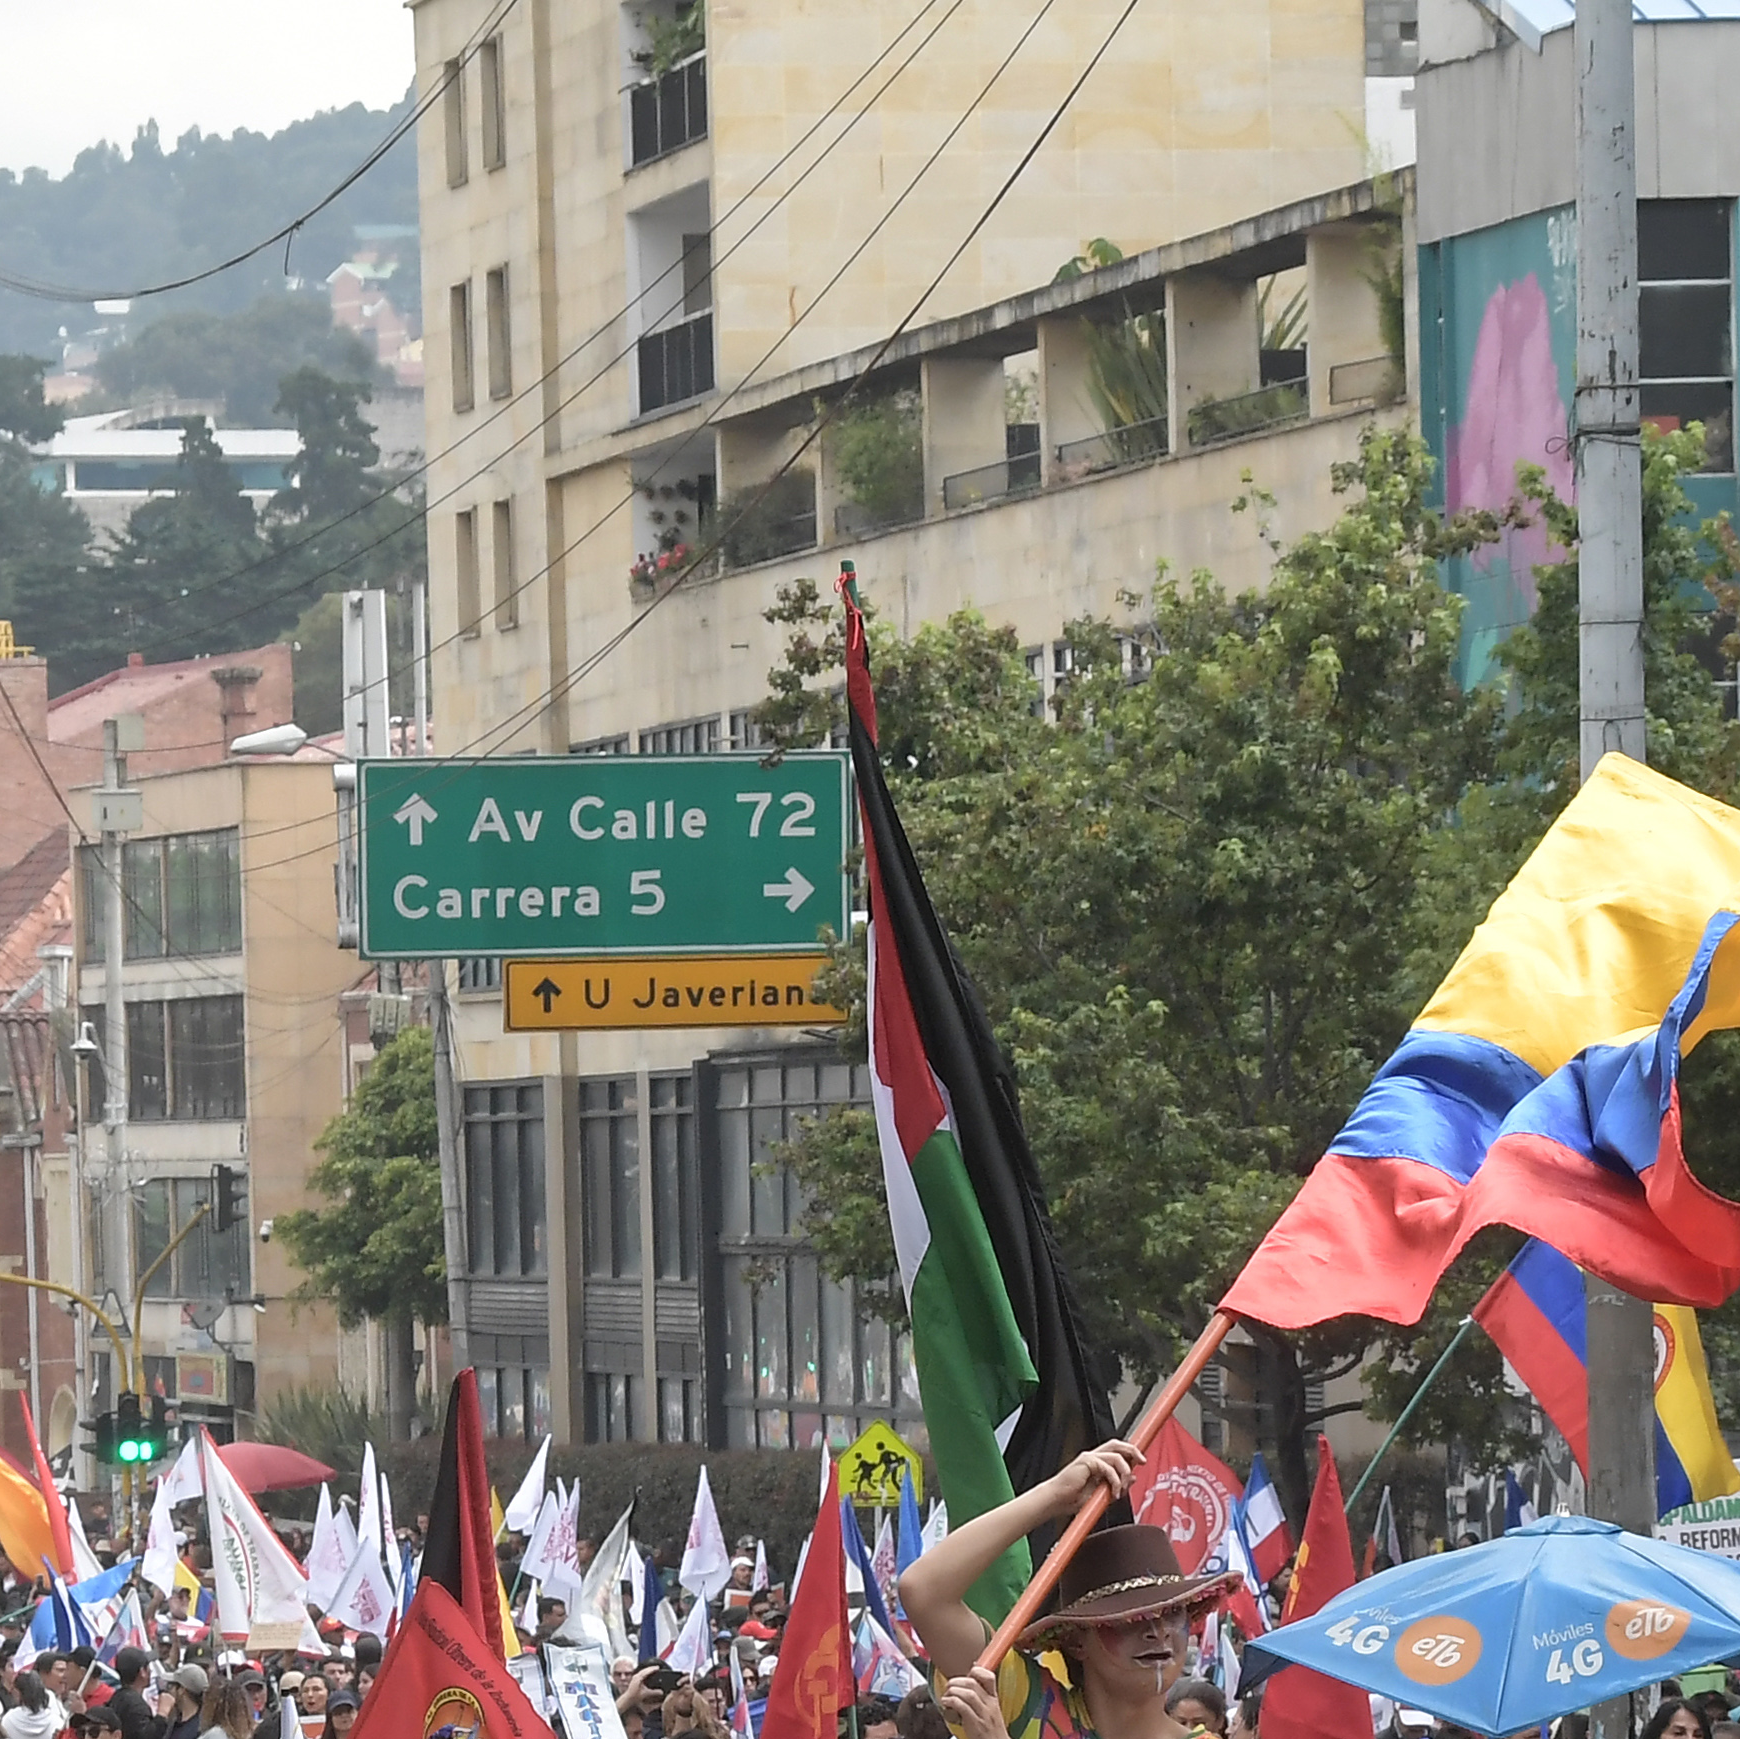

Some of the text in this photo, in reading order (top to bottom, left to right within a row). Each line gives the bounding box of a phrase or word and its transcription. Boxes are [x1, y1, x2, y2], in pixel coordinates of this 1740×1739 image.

[468, 792, 816, 843] Av Calle 72
[393, 870, 666, 920] Carrera 5
[584, 979, 611, 1010] U
[1325, 1615, 1390, 1655] 4G
[1532, 1622, 1595, 1650] Móviles
[1545, 1638, 1604, 1685] 4G
